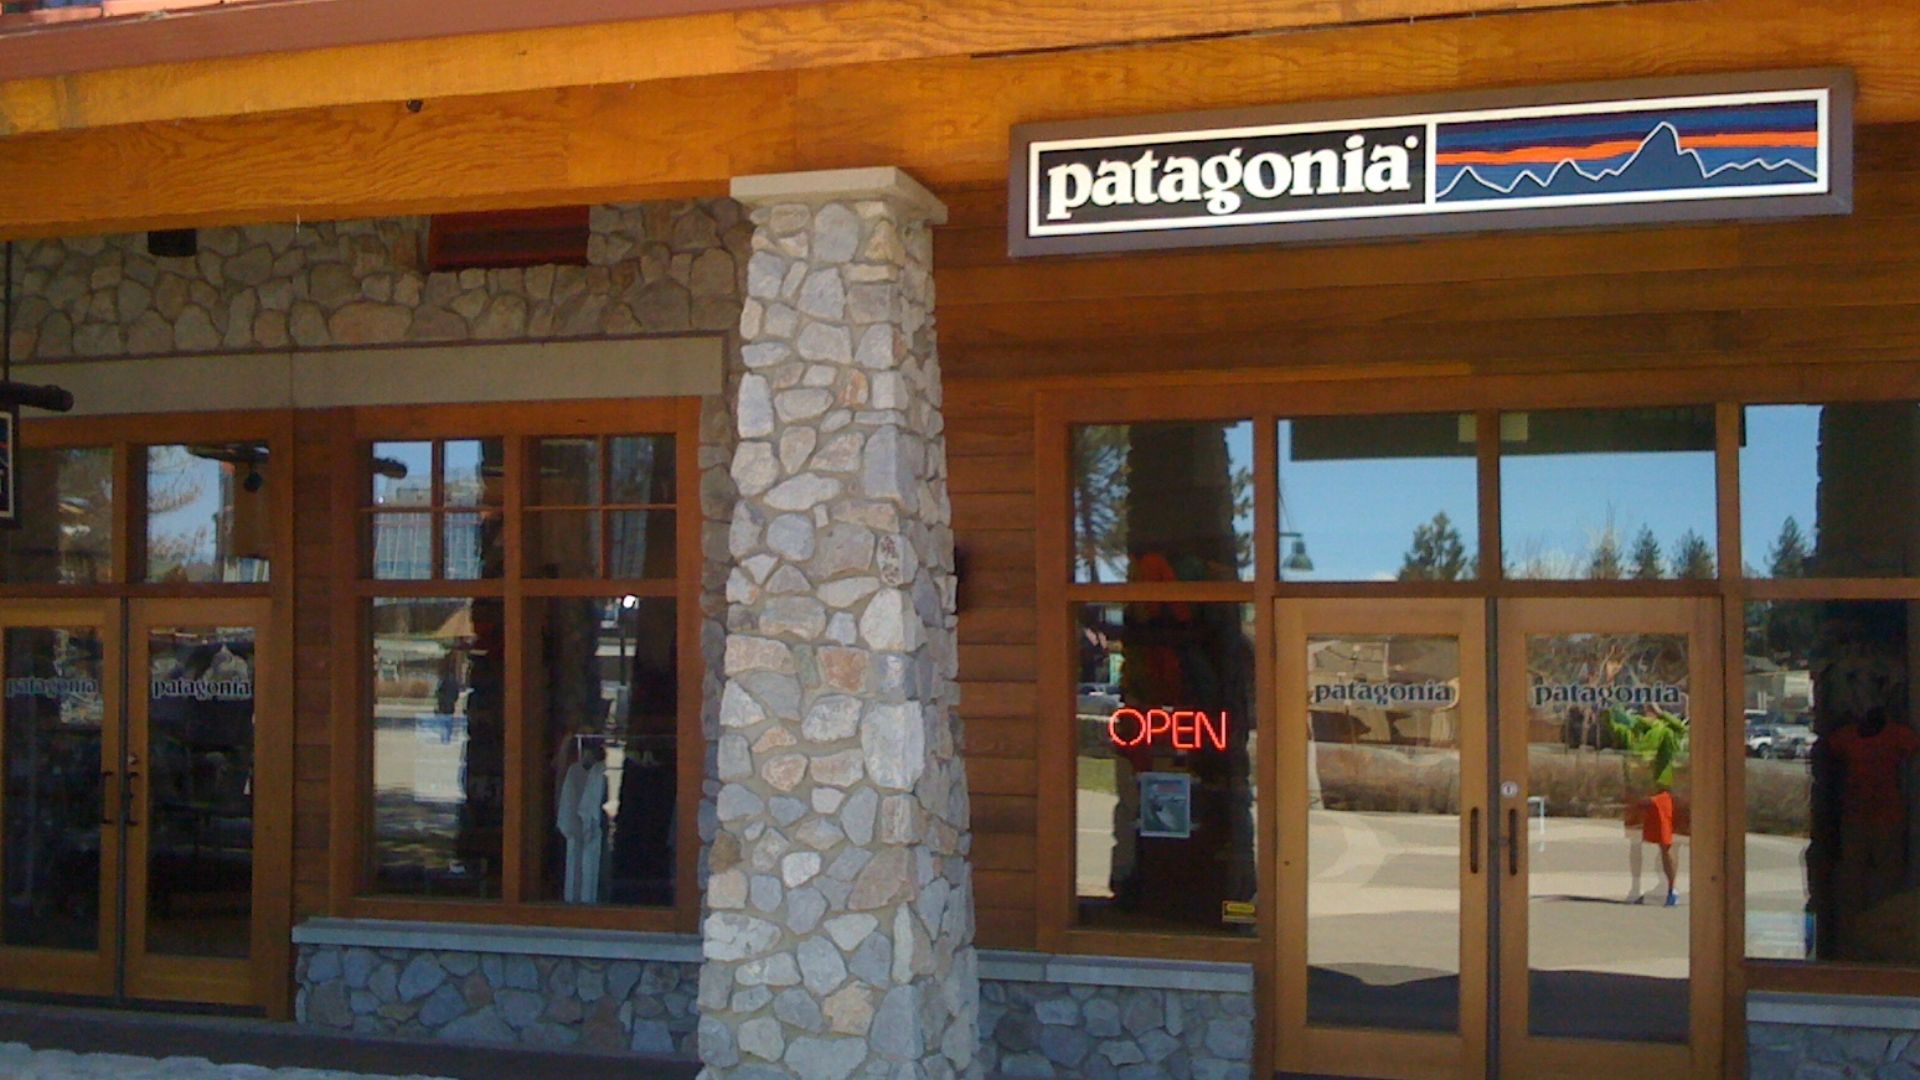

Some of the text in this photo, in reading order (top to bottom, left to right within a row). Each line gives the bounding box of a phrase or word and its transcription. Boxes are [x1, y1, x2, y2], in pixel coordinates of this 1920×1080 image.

[1046, 132, 1419, 218] patagonia
[7, 678, 98, 699] patagonia
[152, 677, 252, 701] patagonia
[1314, 681, 1452, 705] patagonia
[1533, 682, 1681, 707] patagonia
[1108, 707, 1227, 750] OPEN
